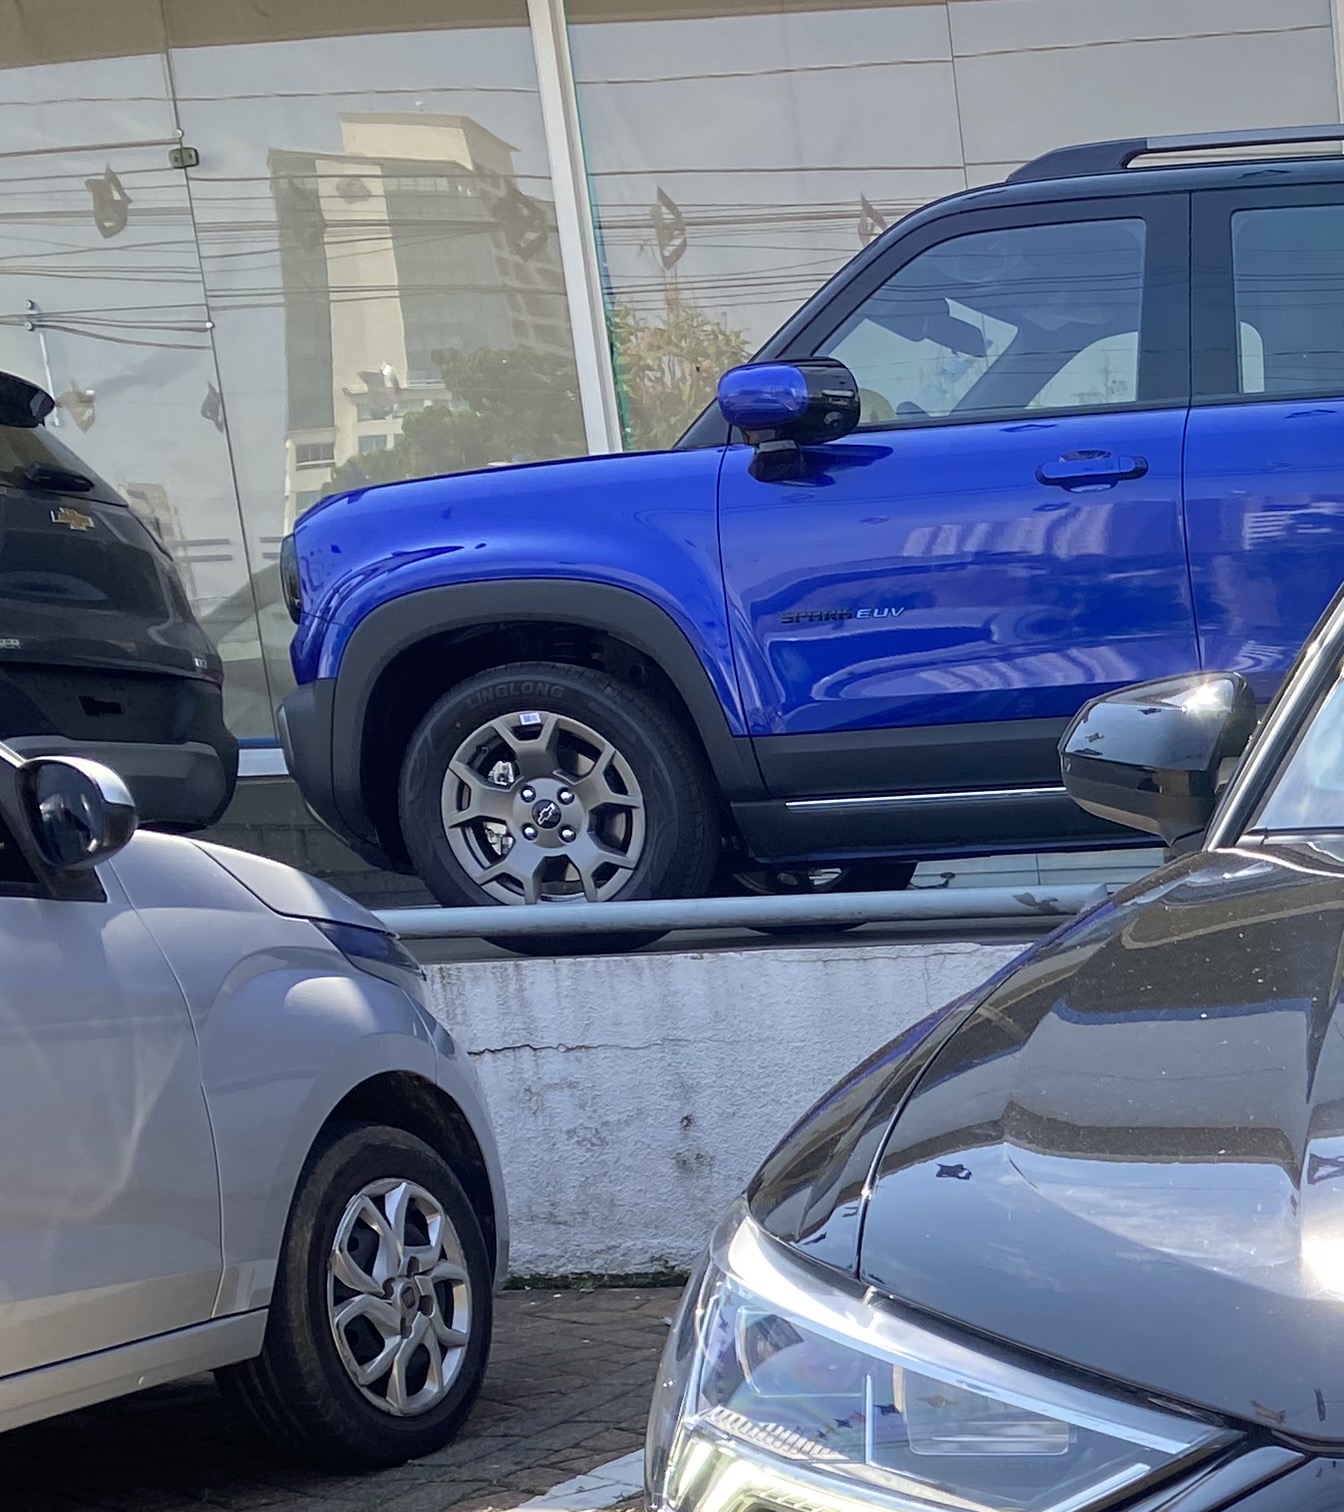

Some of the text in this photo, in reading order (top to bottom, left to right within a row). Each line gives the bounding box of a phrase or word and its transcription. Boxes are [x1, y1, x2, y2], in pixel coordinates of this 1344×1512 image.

[781, 607, 904, 624] SPARK EUV
[467, 681, 566, 706] LINGLONG
